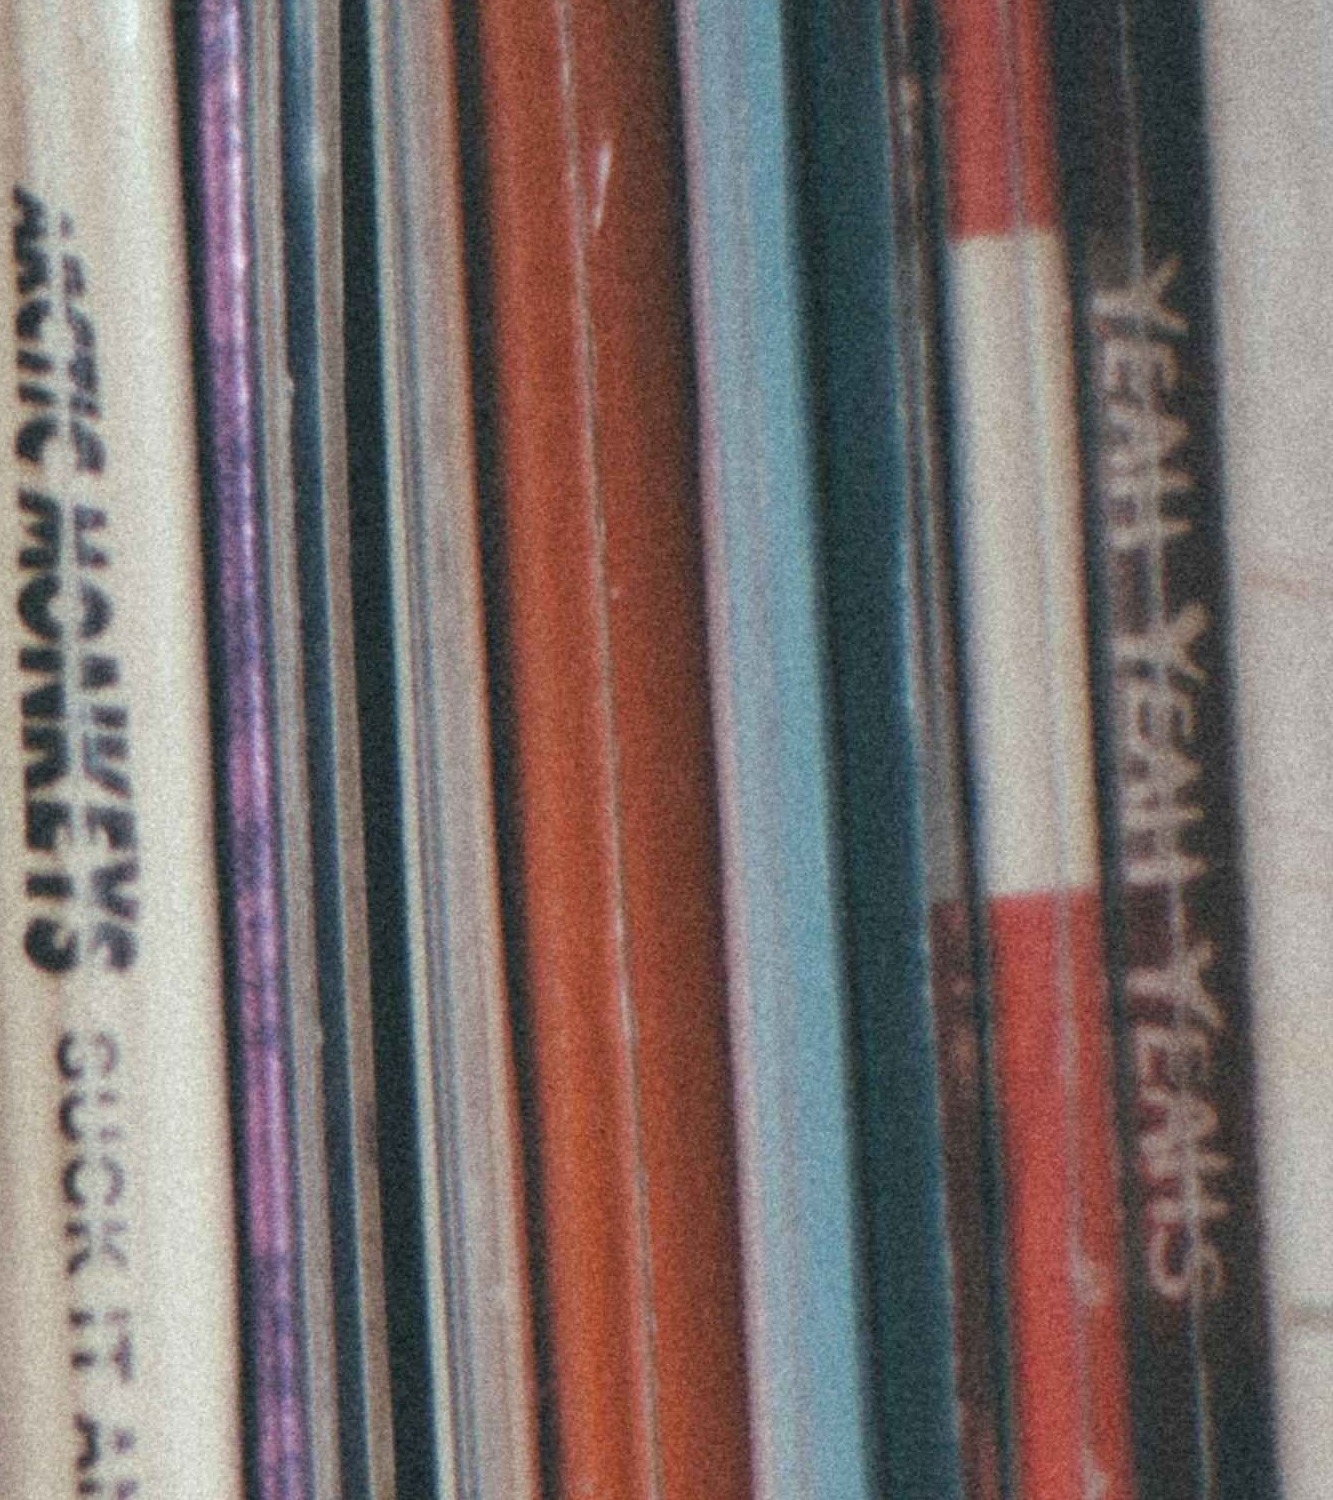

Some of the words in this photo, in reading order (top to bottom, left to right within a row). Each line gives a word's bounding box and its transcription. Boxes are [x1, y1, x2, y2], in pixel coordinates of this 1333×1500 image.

[12, 187, 109, 469] ARCTIC
[1089, 255, 1190, 549] YEAH
[18, 490, 138, 975] MONKEYS
[1110, 603, 1210, 885] YEAH
[55, 1031, 126, 1275] SUCK
[1133, 941, 1228, 1301] YEAHS
[67, 1306, 136, 1372] IT
